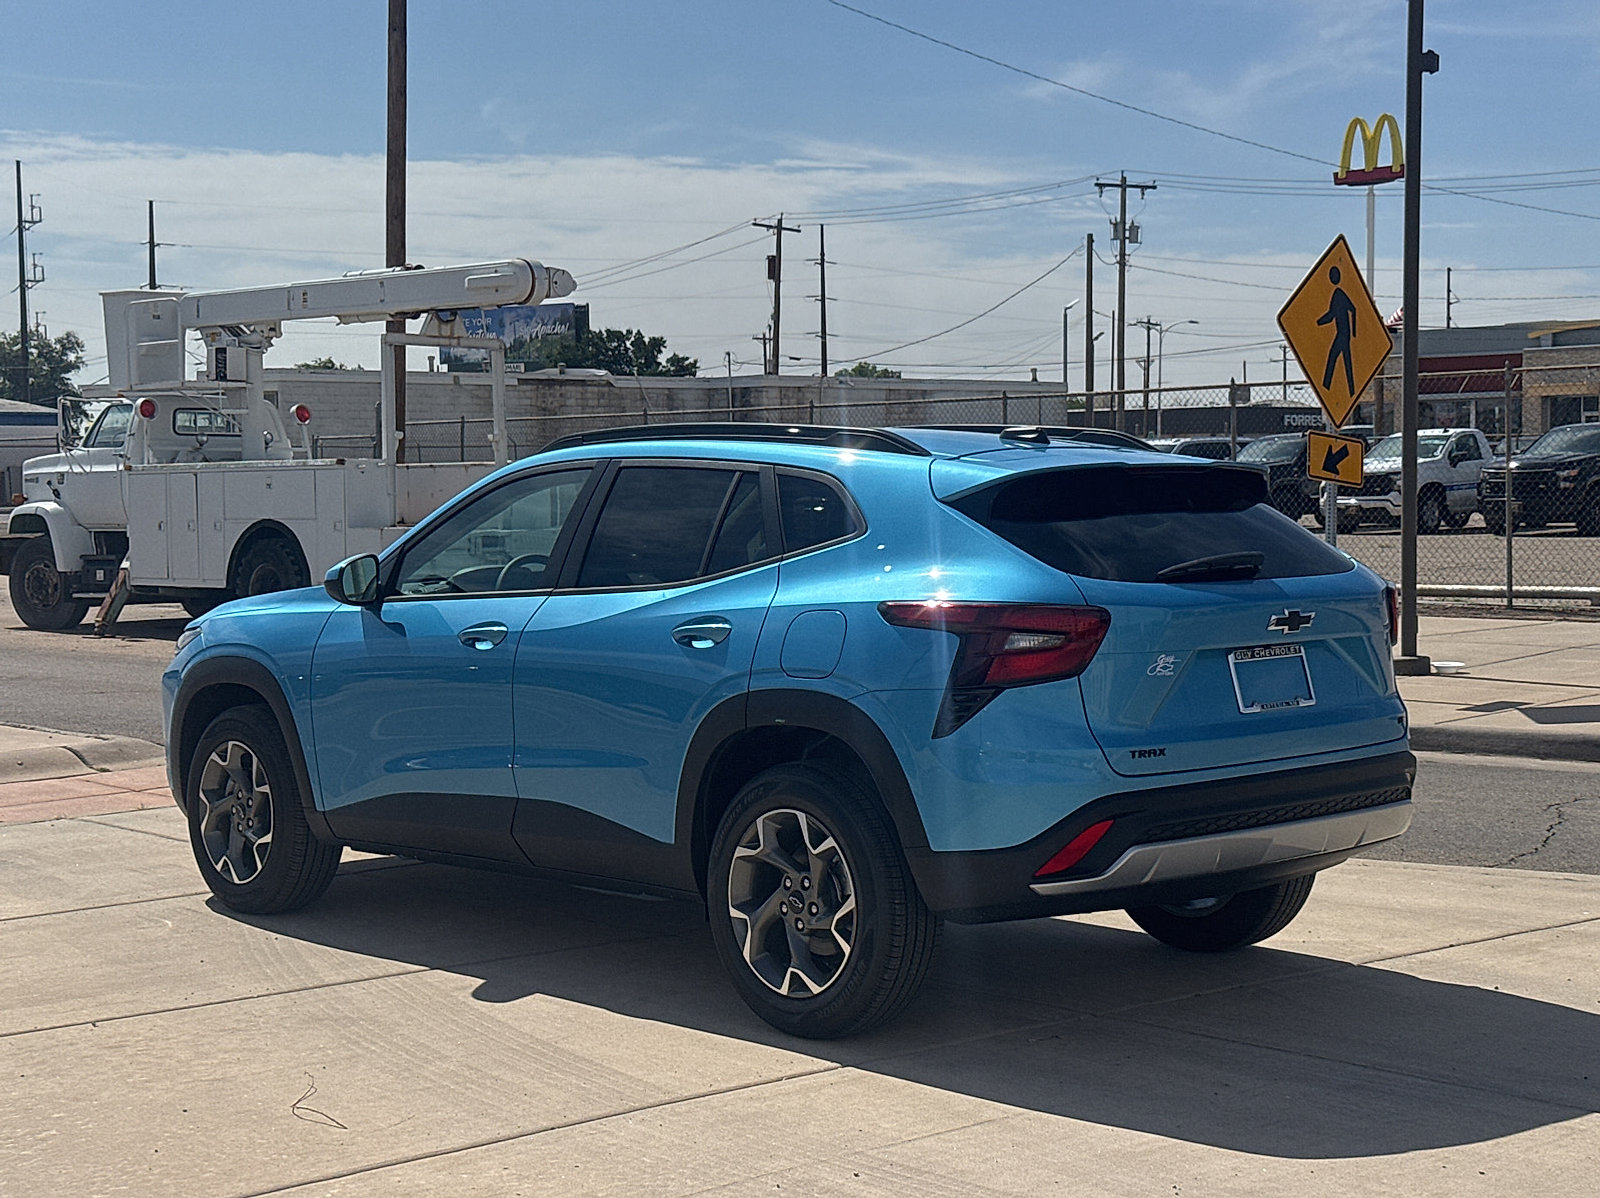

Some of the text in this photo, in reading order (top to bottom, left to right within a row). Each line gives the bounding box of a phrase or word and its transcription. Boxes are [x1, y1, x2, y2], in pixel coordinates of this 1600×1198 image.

[1283, 414, 1323, 427] FORRES
[1235, 646, 1300, 660] GUY CHEVROLET
[1129, 747, 1167, 760] TRAX
